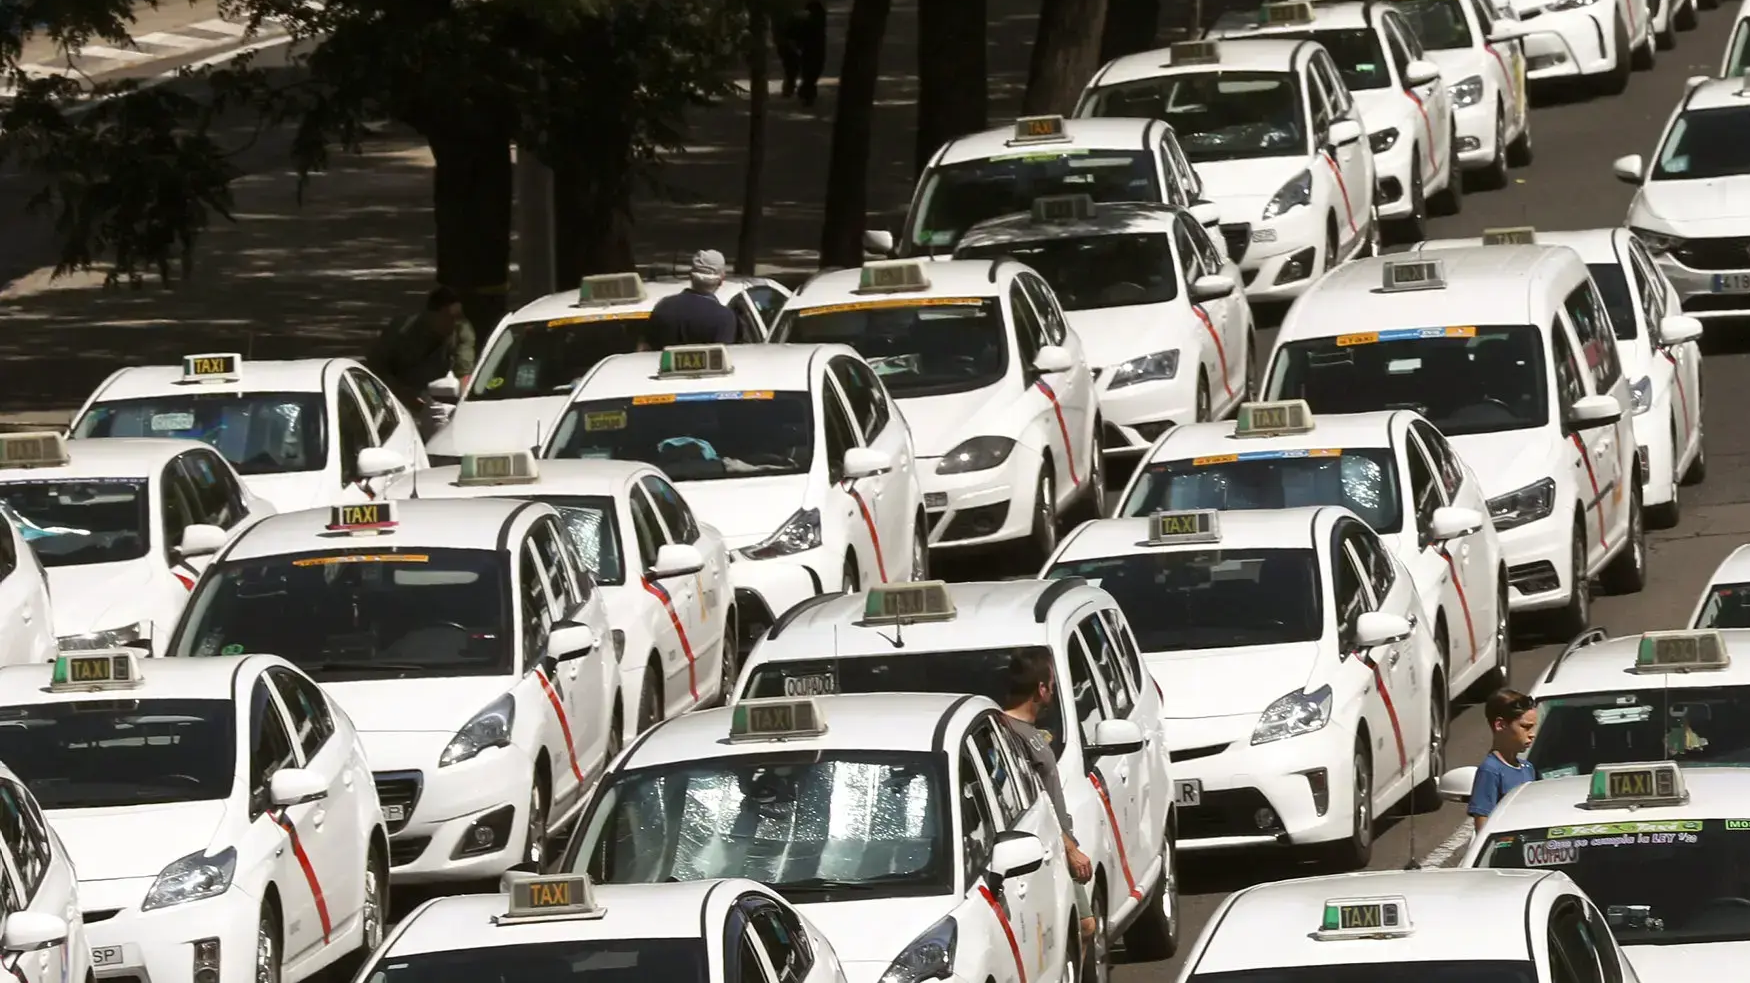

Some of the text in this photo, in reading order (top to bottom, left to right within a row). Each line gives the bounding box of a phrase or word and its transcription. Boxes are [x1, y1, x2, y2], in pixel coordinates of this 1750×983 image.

[1028, 122, 1052, 135] TAXI
[195, 359, 225, 373] TAXI
[676, 353, 706, 368] TAXI
[1253, 410, 1286, 427] TAXI
[344, 506, 377, 523] TAXI
[1163, 517, 1196, 534] TAXI
[72, 661, 109, 678] TAXI
[752, 707, 790, 730] TAXI
[1613, 775, 1652, 793] TAXI
[1590, 833, 1635, 848] cumpla
[1637, 832, 1650, 843] la
[1652, 833, 1676, 843] LEY
[531, 882, 569, 905] TAXI
[1343, 907, 1379, 925] TAXI
[93, 949, 115, 964] SP
